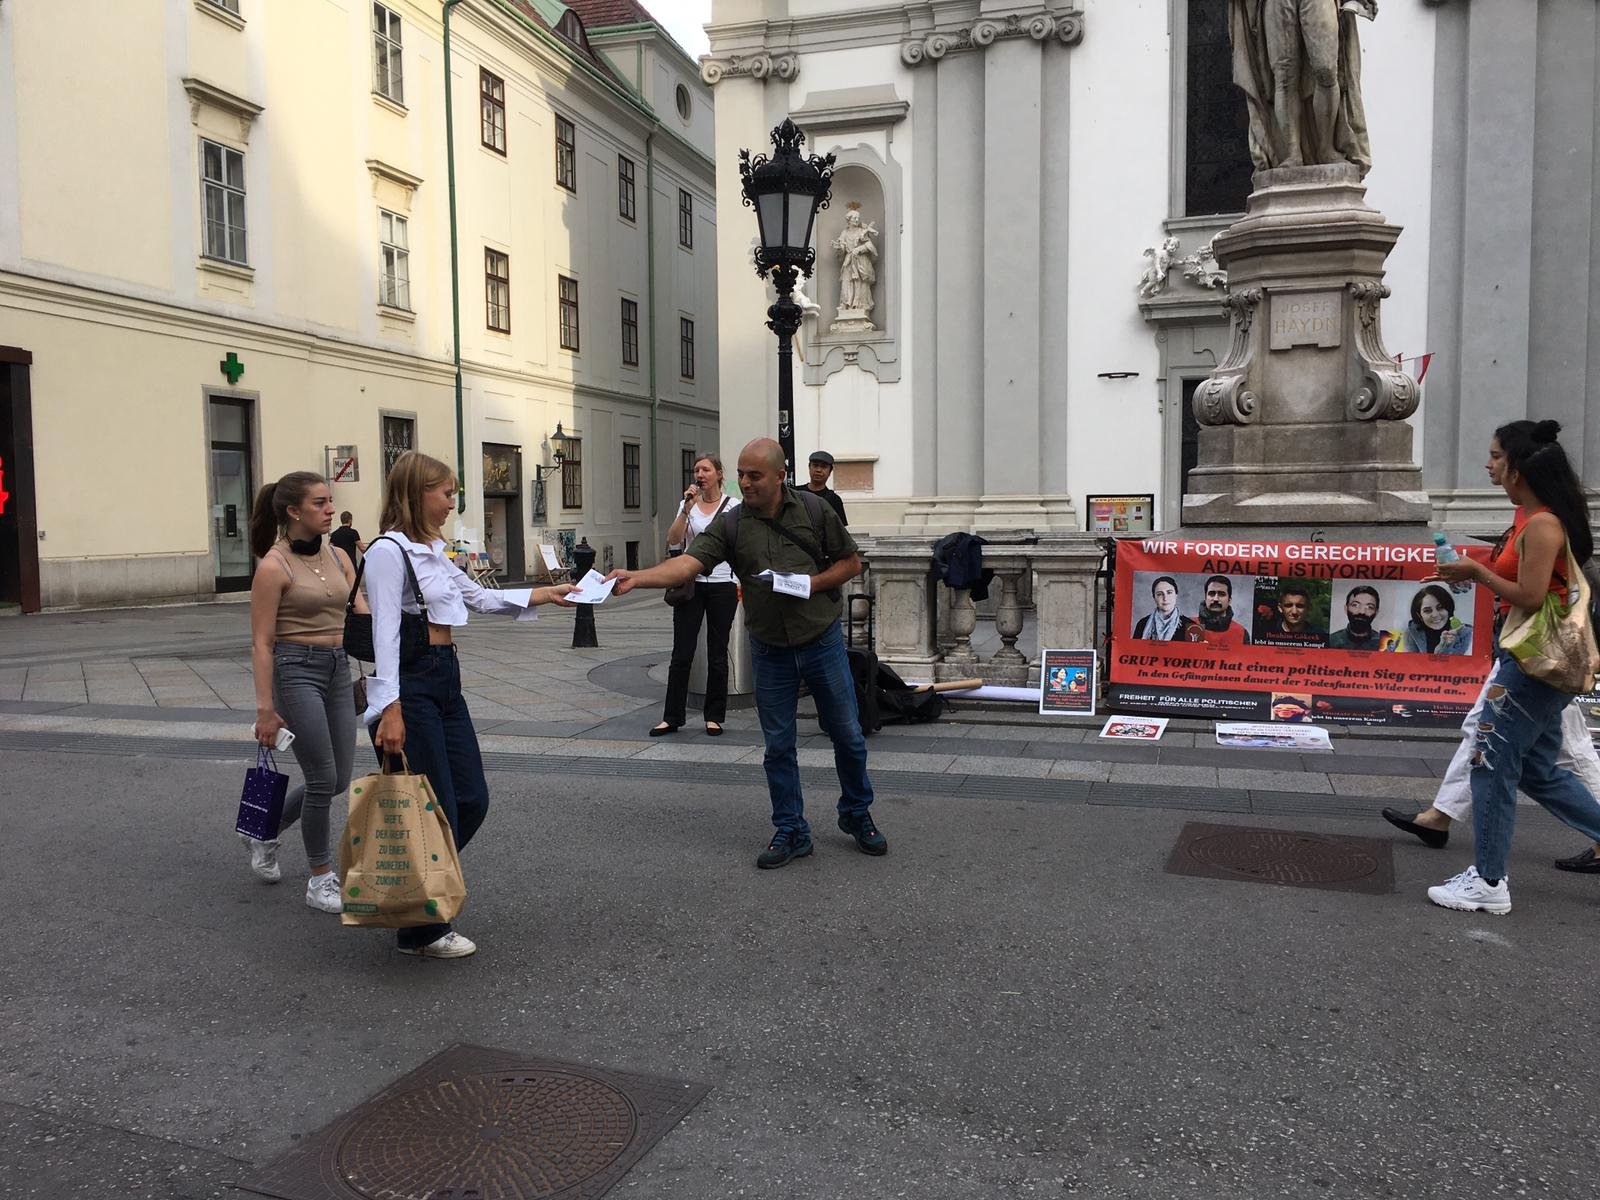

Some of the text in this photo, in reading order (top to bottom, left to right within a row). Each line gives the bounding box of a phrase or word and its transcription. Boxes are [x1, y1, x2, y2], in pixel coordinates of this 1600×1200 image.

[1274, 317, 1337, 334] HAYDN
[1142, 540, 1178, 555] WIR
[1184, 542, 1279, 559] FORDERN
[1202, 559, 1282, 577] ADALET
[1118, 654, 1487, 686] GRUP YORUM hat einen politischen Sieg errungen!
[1137, 669, 1149, 678] In
[1151, 670, 1170, 679] den
[1171, 670, 1241, 683] Gefängnissen
[1243, 673, 1280, 684] dauert
[1282, 677, 1301, 686] der
[1303, 678, 1441, 695] Todesfasten-Widerstand
[1118, 693, 1156, 701] FREIHEIT
[1159, 694, 1179, 703] FÜR
[1201, 698, 1258, 707] POLITISCHEN
